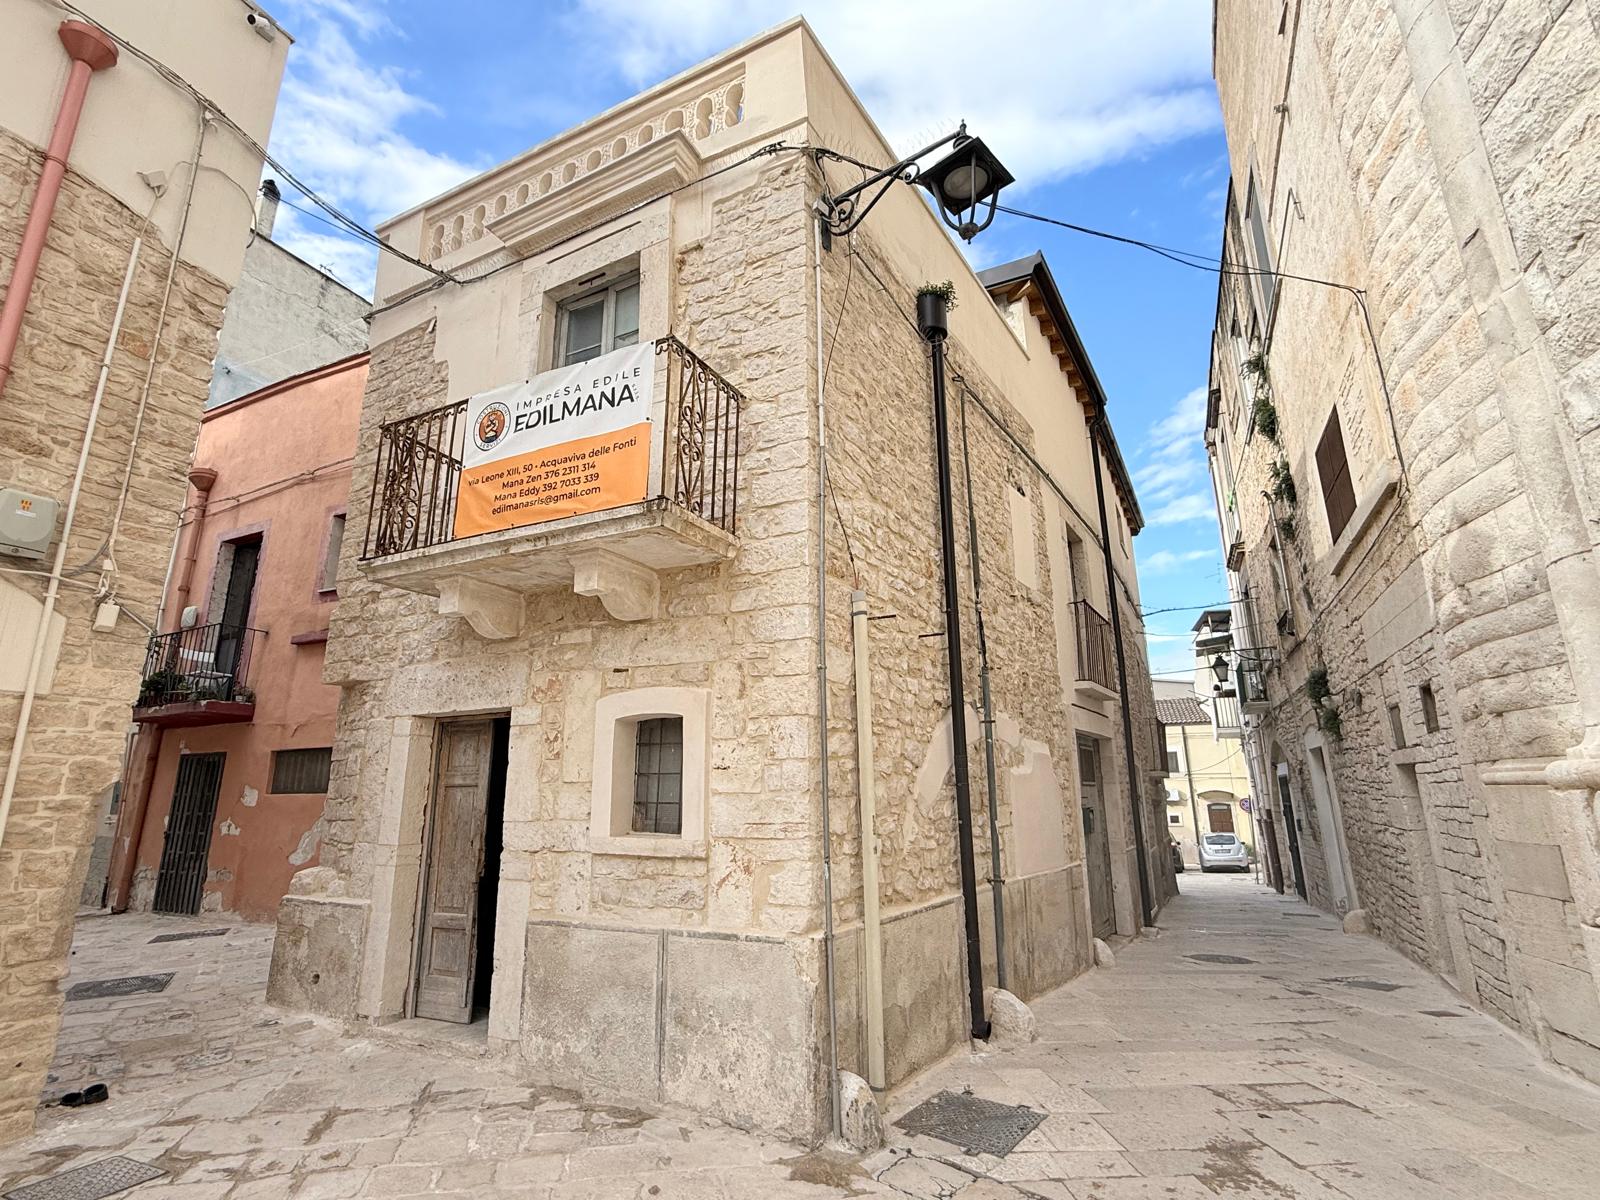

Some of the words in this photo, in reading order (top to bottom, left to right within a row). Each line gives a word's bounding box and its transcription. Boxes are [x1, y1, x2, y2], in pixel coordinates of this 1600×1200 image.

[516, 384, 582, 411] IMPRESA
[592, 367, 641, 389] EDILE
[513, 384, 635, 433] EDILMANA
[468, 478, 480, 487] via
[481, 471, 504, 484] Leone
[506, 465, 521, 476] XIII,
[522, 463, 533, 473] 50
[540, 452, 586, 469] Acquaviva
[588, 446, 610, 458] delle
[613, 437, 637, 452] Fonti
[502, 478, 523, 490] Mana
[525, 474, 542, 484] Zen
[543, 469, 560, 480] 376
[562, 465, 580, 476] 2311
[581, 461, 597, 472] 314
[491, 486, 601, 515] edilmanasrls@gmail.com
[494, 492, 517, 503] Mana
[519, 487, 540, 500] Eddy
[542, 482, 558, 493] 392
[559, 477, 582, 489] 7033
[583, 472, 600, 483] 339
